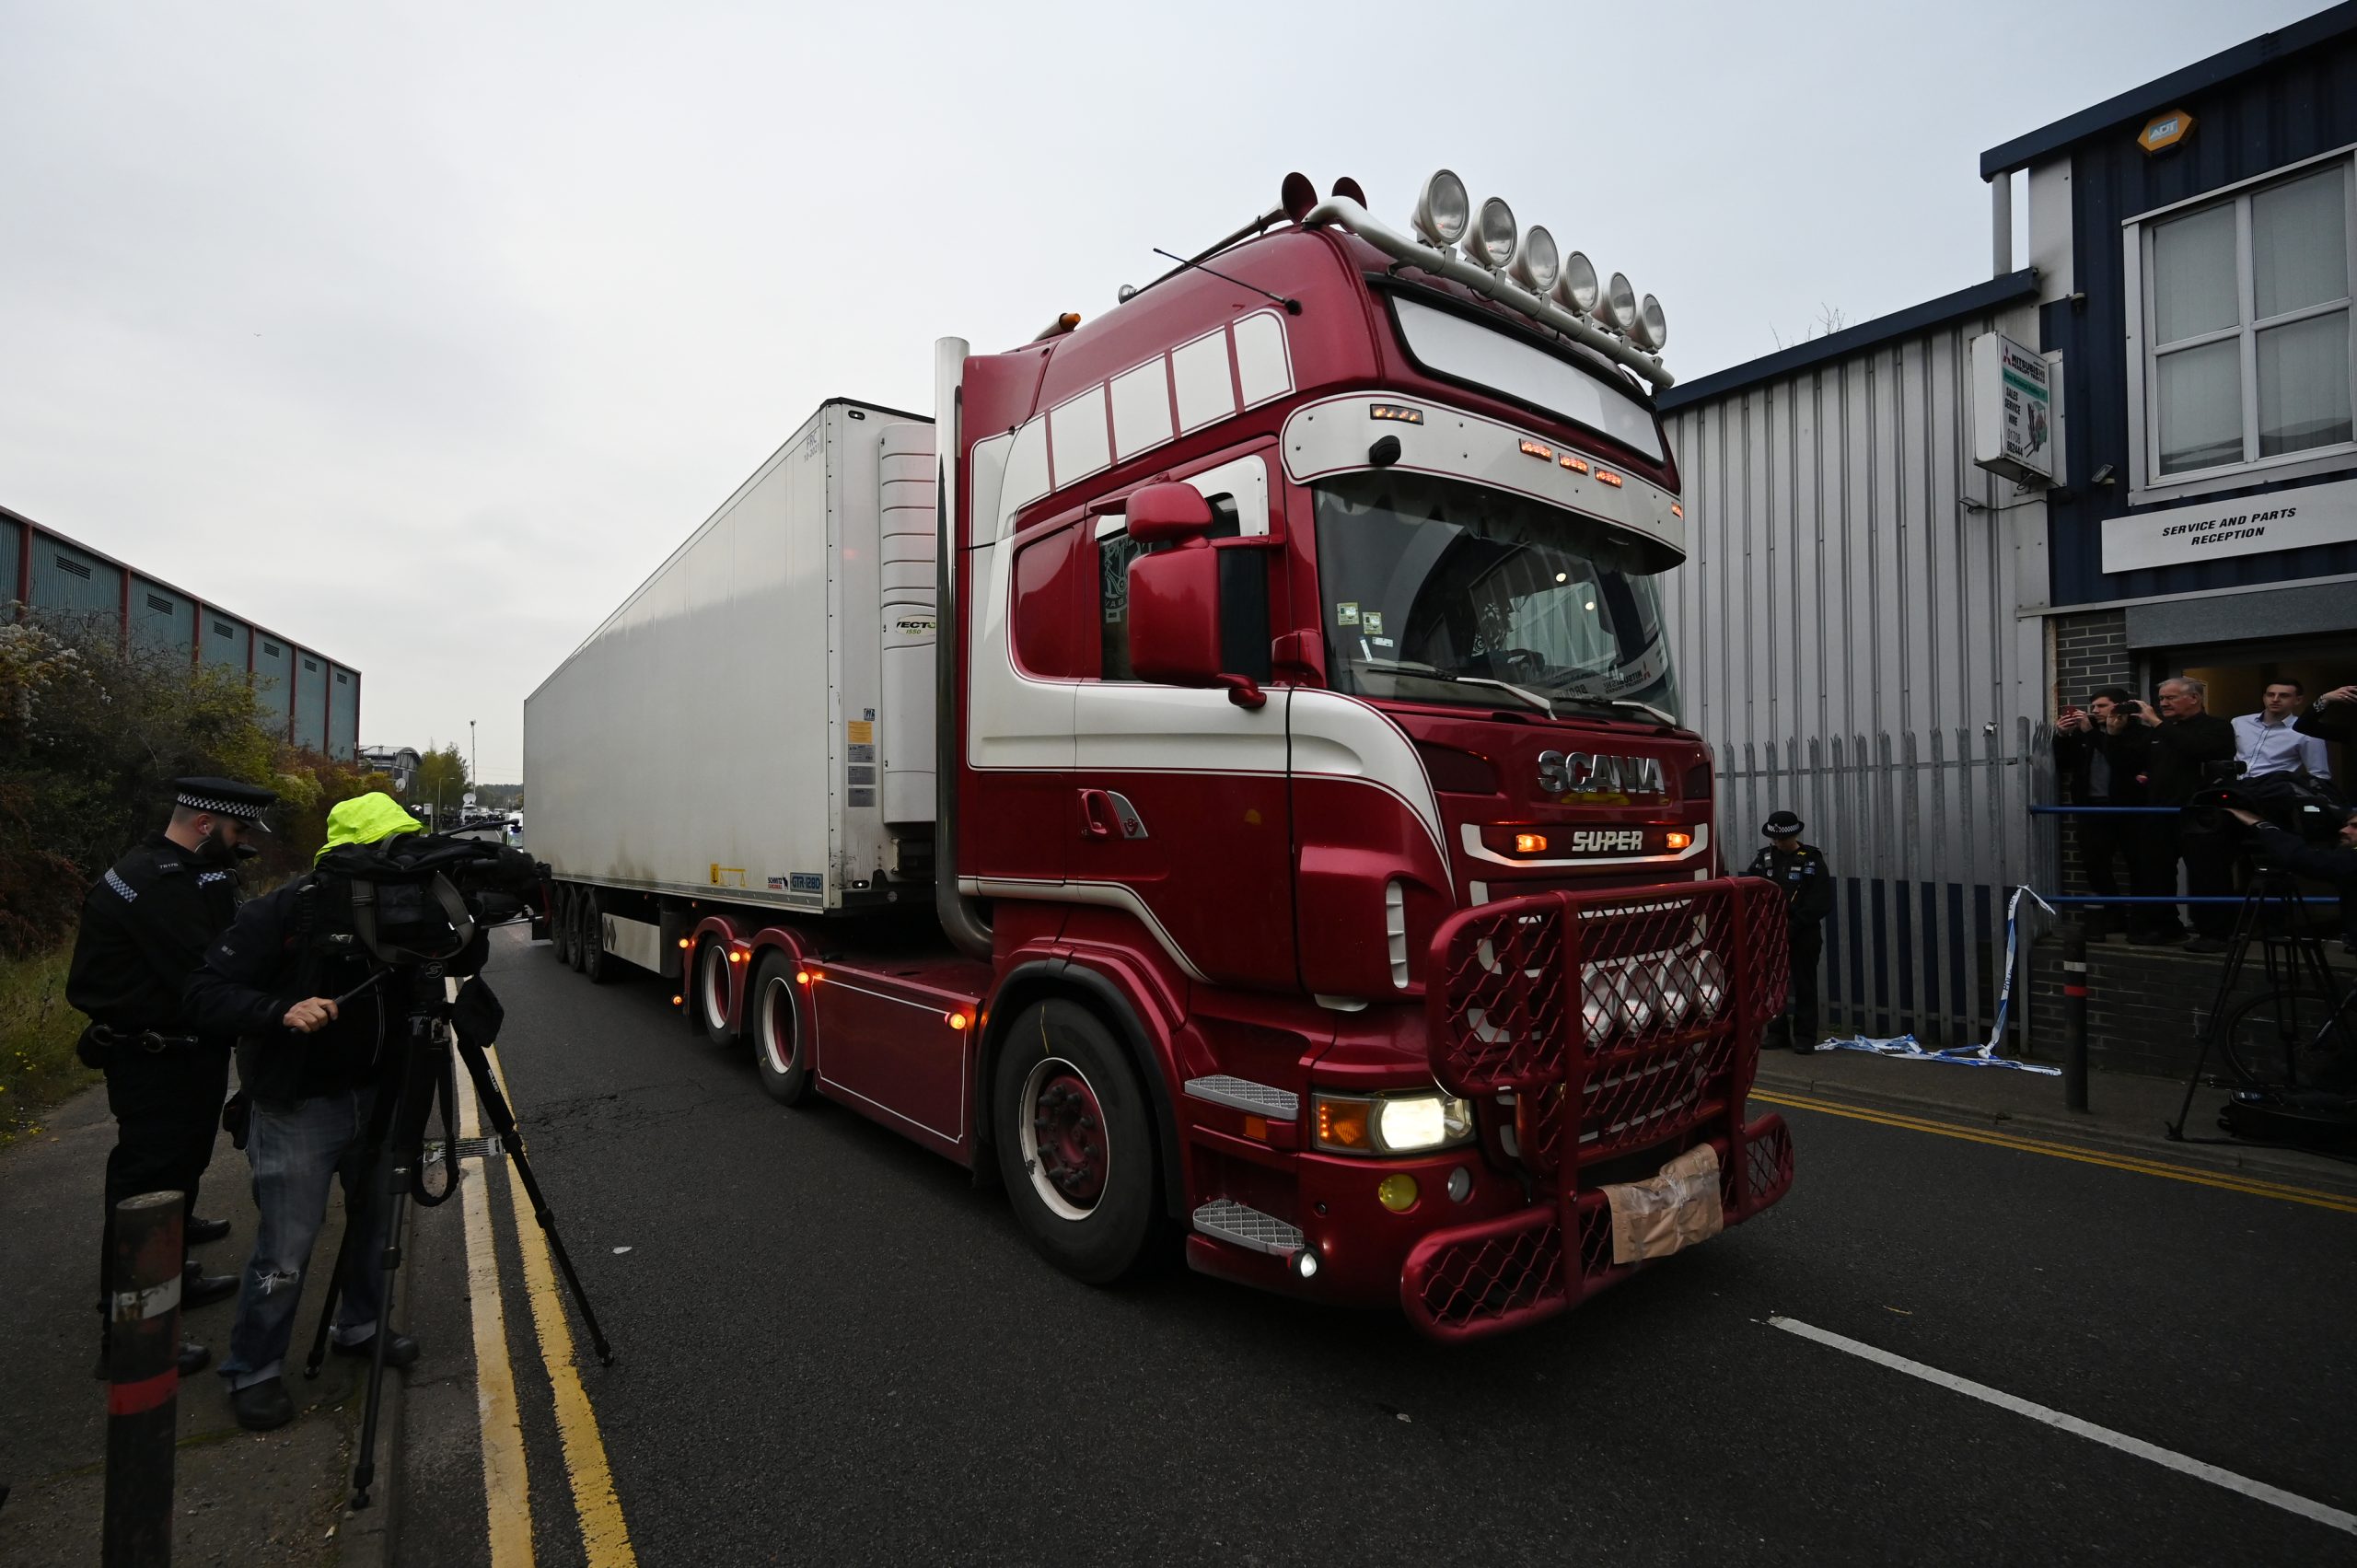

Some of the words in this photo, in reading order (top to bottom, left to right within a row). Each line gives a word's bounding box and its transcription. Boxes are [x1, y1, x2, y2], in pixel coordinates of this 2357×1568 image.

[2150, 120, 2177, 141] ADT
[2012, 354, 2045, 378] MITSUBISHI
[2006, 387, 2018, 401] SALES
[2004, 398, 2021, 415] SERVICE
[2008, 412, 2018, 426] HIRE
[2007, 427, 2021, 445] 01708
[2006, 440, 2023, 458] 862444
[2163, 520, 2216, 537] SERVICE
[2219, 516, 2247, 528] AND
[2251, 507, 2296, 523] PARTS
[2191, 527, 2265, 545] RECEPTION
[896, 621, 936, 629] VECTO
[1538, 749, 1666, 794] SCANIA
[1572, 830, 1643, 852] SUPER
